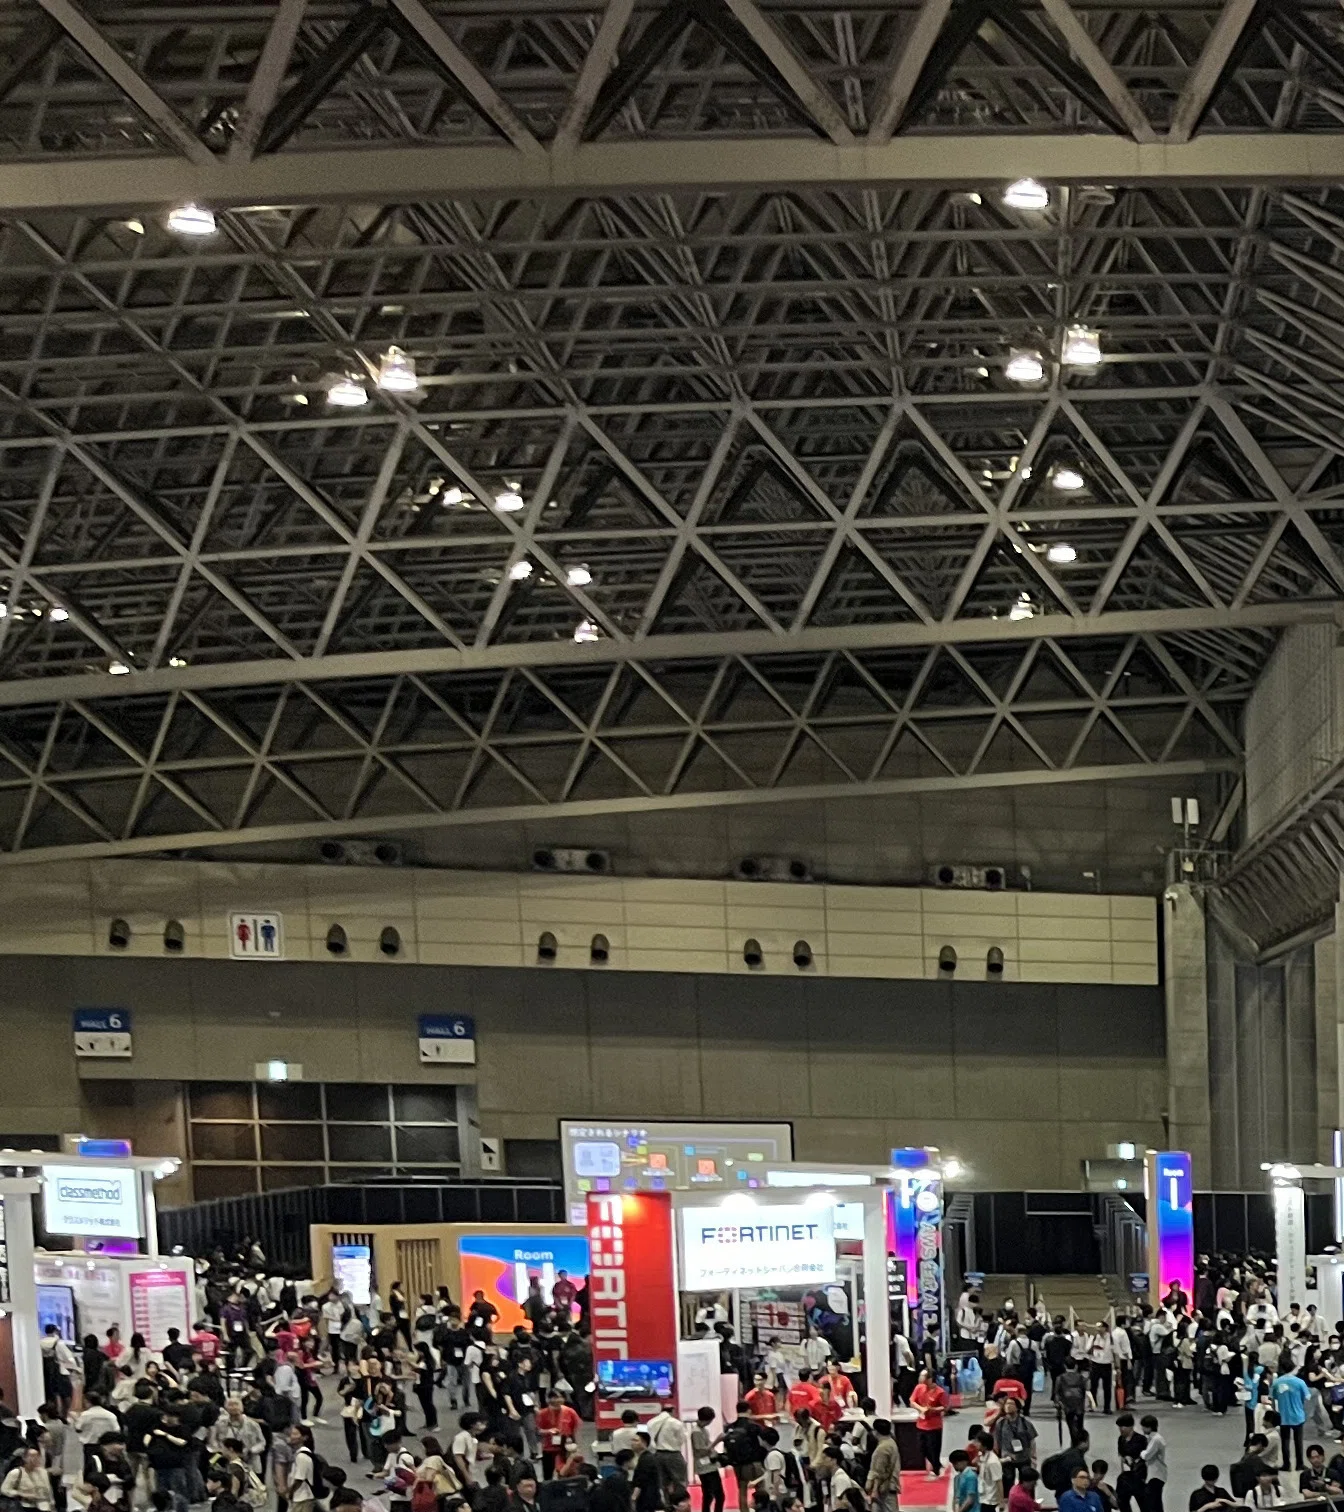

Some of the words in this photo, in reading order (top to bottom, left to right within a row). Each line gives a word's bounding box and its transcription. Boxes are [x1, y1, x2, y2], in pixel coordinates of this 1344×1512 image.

[109, 1013, 122, 1029] 6
[453, 1021, 466, 1036] 6
[701, 1224, 819, 1245] FORTINET
[513, 1249, 554, 1261] Room
